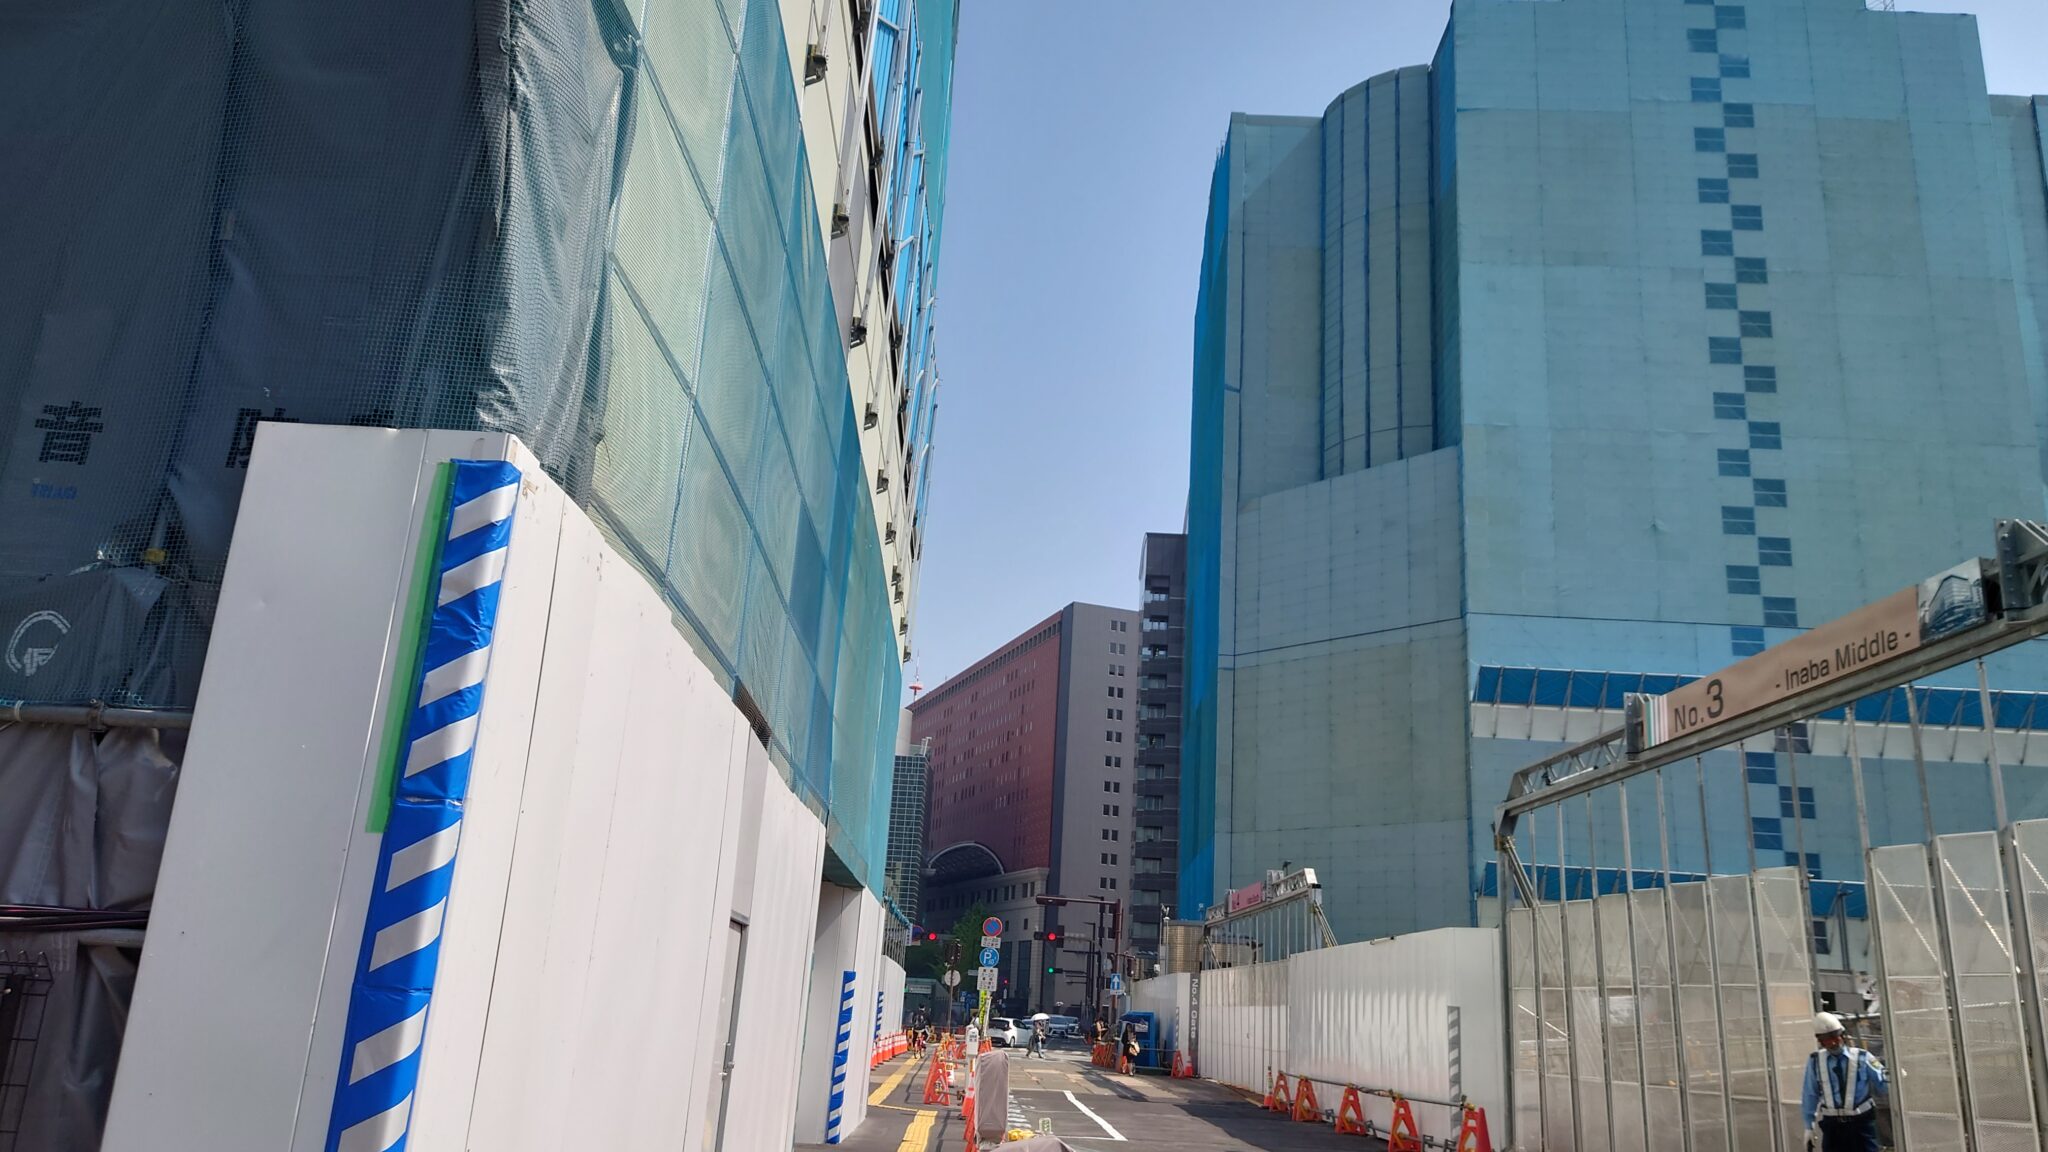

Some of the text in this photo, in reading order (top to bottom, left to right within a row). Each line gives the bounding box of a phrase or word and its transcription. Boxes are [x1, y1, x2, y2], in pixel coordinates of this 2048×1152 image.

[34, 400, 104, 466] 音
[1673, 678, 1724, 734] No.3
[1785, 659, 1830, 691] Inaba
[1834, 629, 1899, 672] Middle
[1190, 978, 1199, 1039] No.4 Gate
